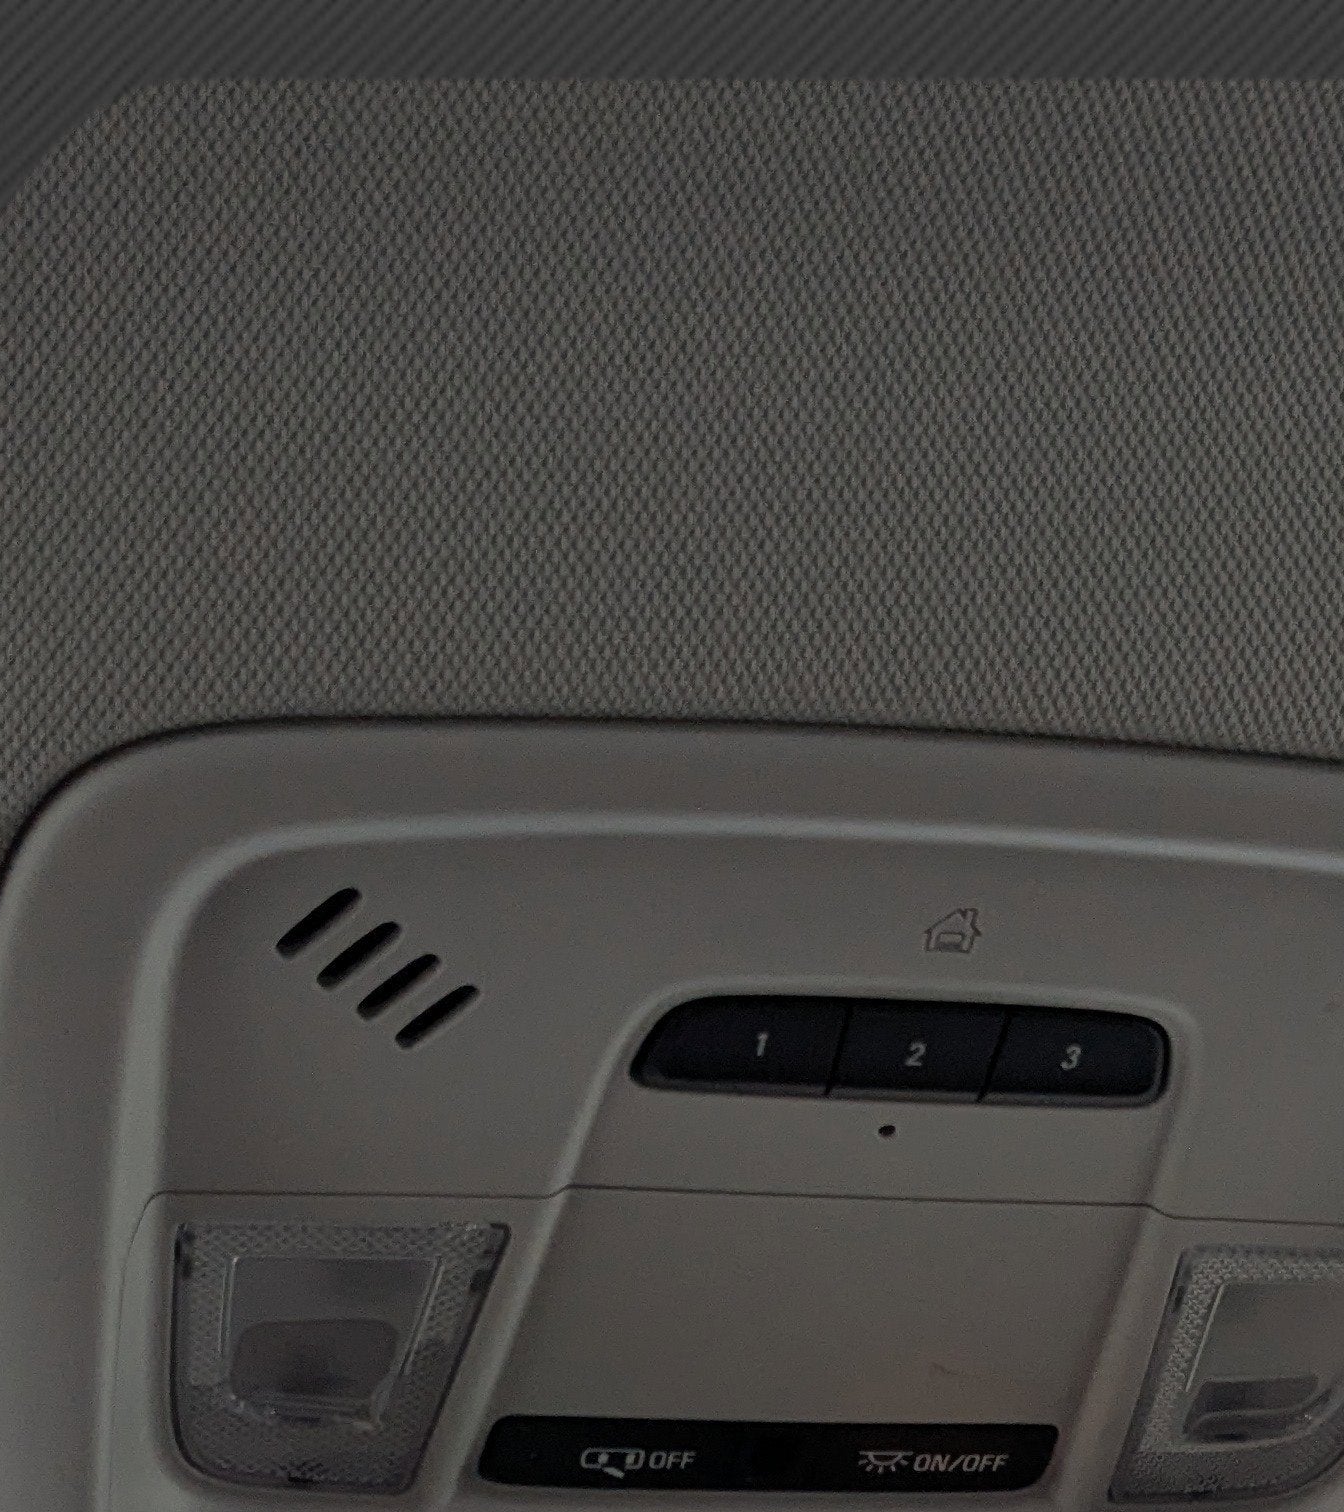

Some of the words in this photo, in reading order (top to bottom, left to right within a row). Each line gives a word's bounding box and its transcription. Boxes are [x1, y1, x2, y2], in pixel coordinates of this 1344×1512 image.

[755, 1032, 768, 1056] 1
[905, 1042, 926, 1067] 2
[1059, 1044, 1082, 1070] 3
[648, 1451, 698, 1470] OFF
[913, 1453, 1009, 1472] ON/OFF
